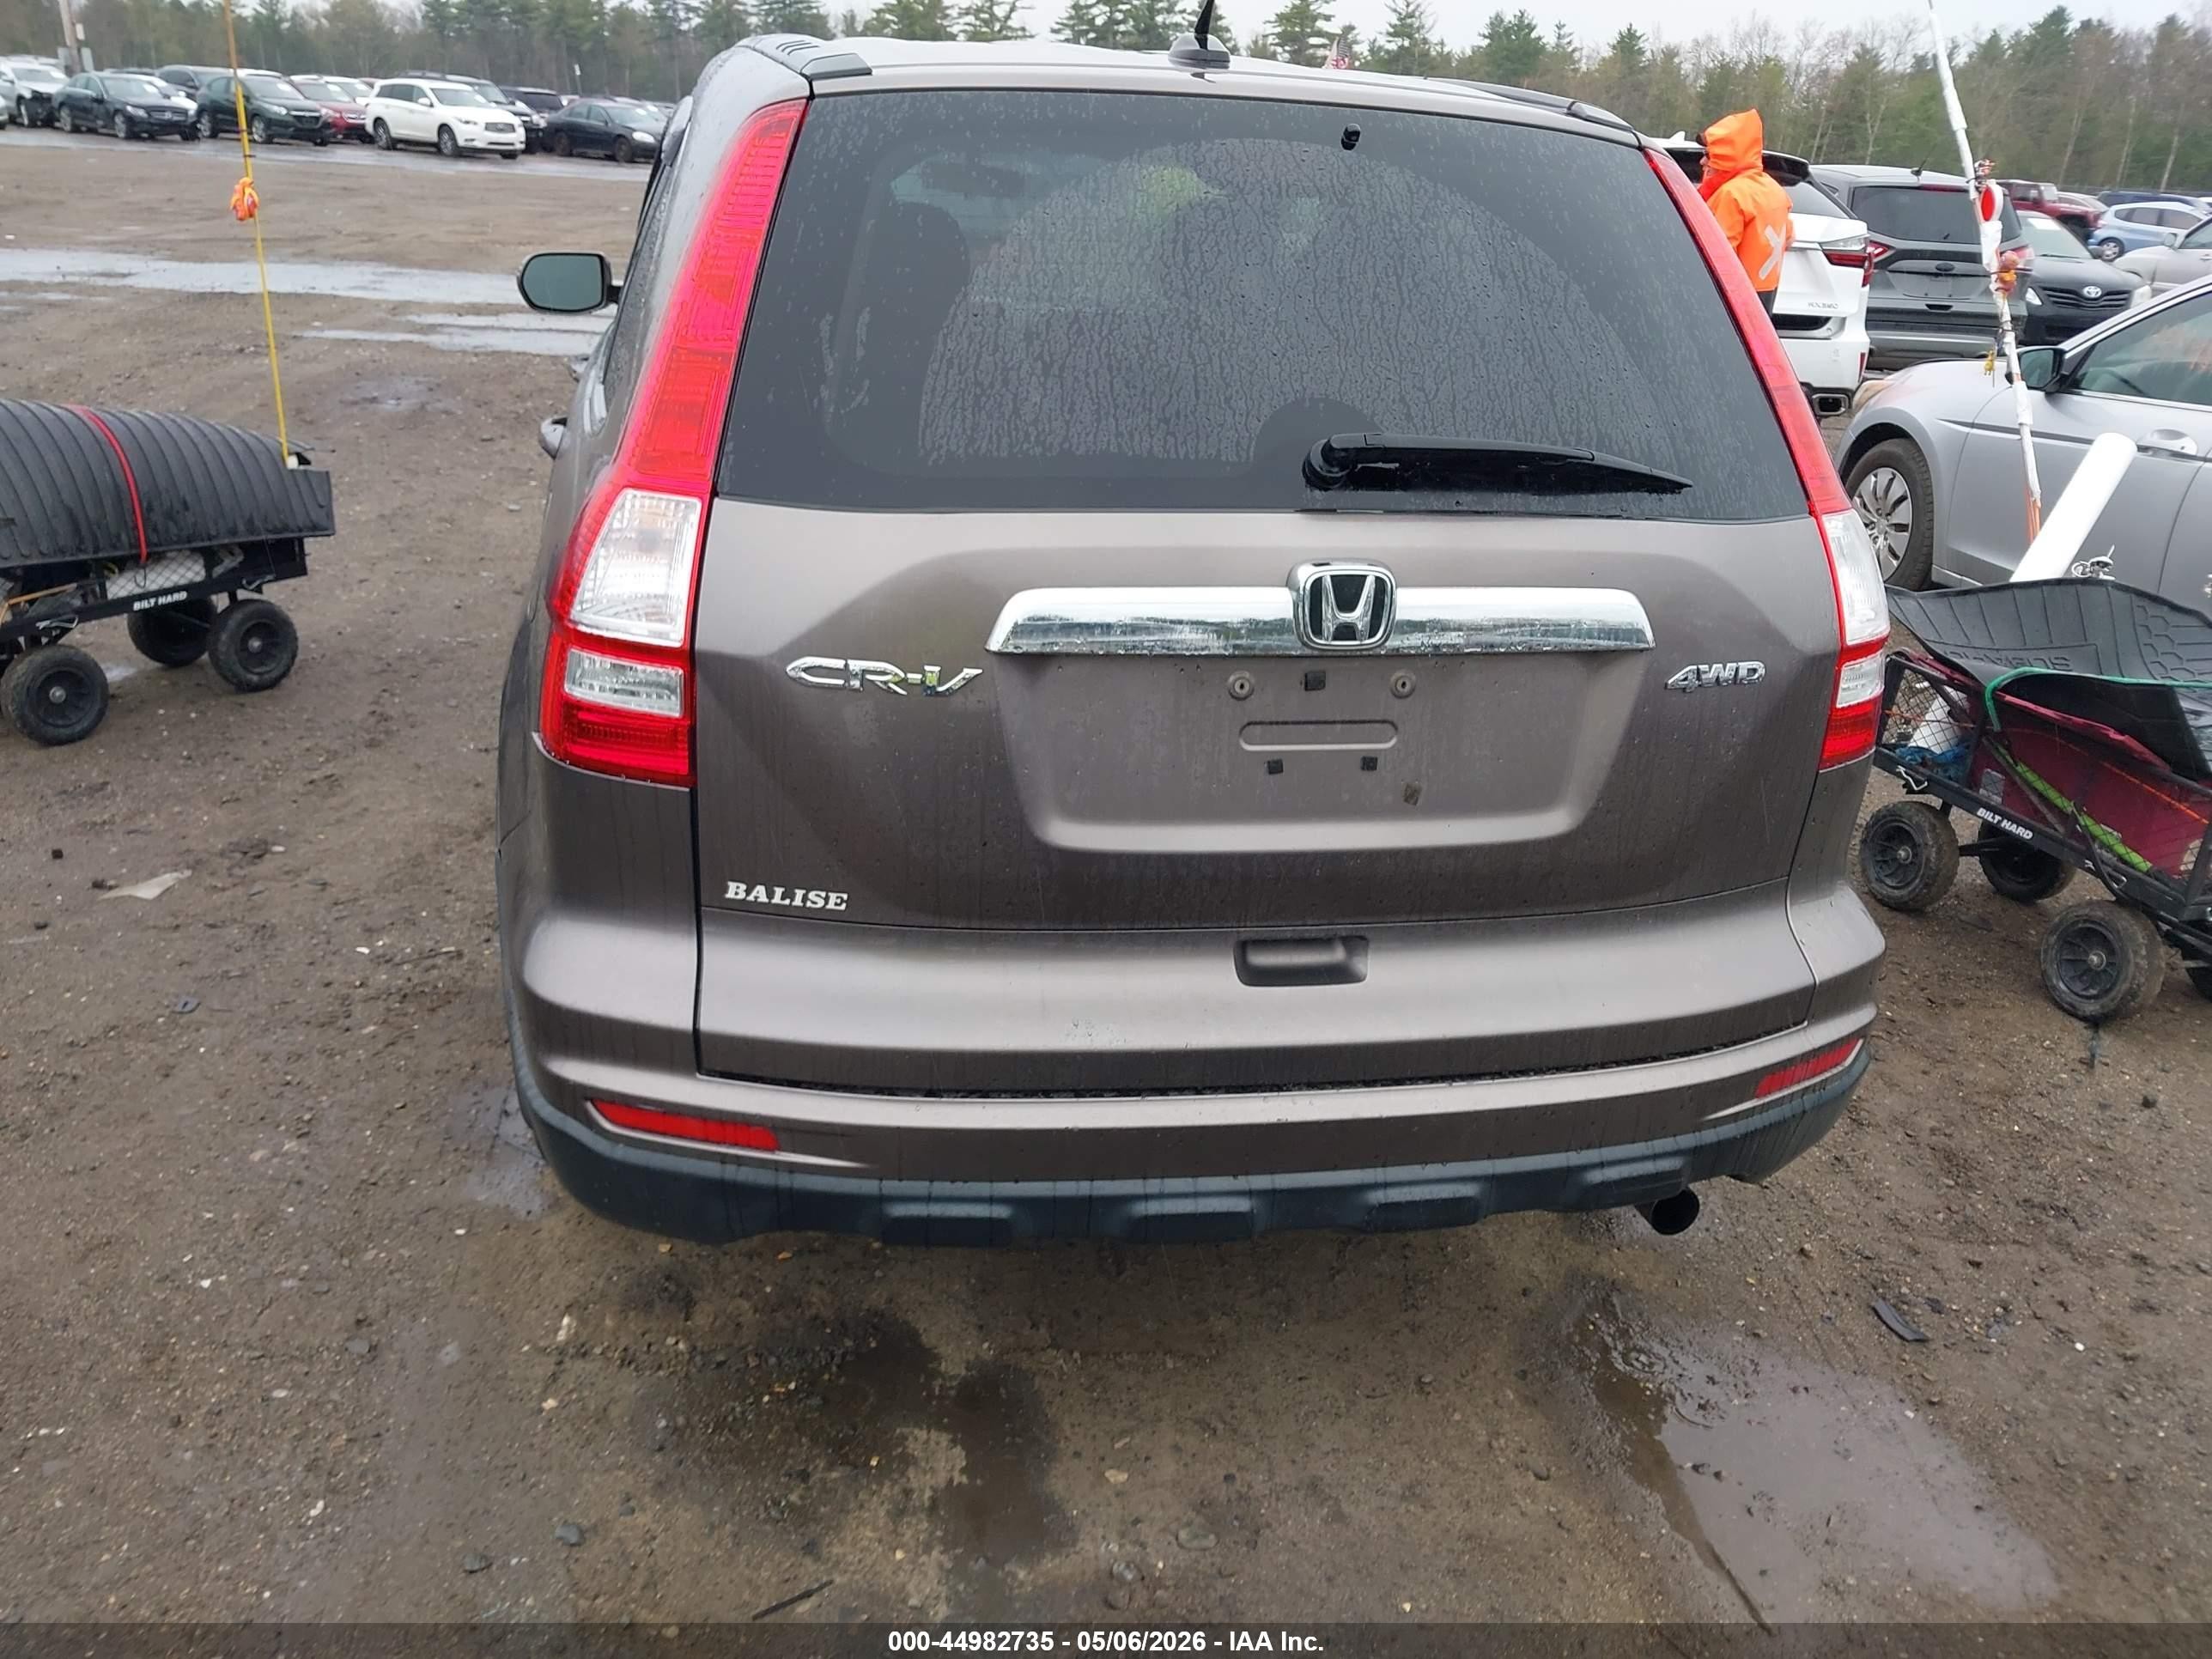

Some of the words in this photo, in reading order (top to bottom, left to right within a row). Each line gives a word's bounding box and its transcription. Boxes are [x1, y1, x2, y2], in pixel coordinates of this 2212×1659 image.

[133, 597, 156, 611] BILT
[157, 591, 188, 606] HARD
[786, 656, 983, 696] CR-V
[1665, 660, 1765, 693] 4WD
[1977, 807, 2002, 824] BILT
[2001, 819, 2033, 840] HARD
[725, 881, 848, 911] BALISE
